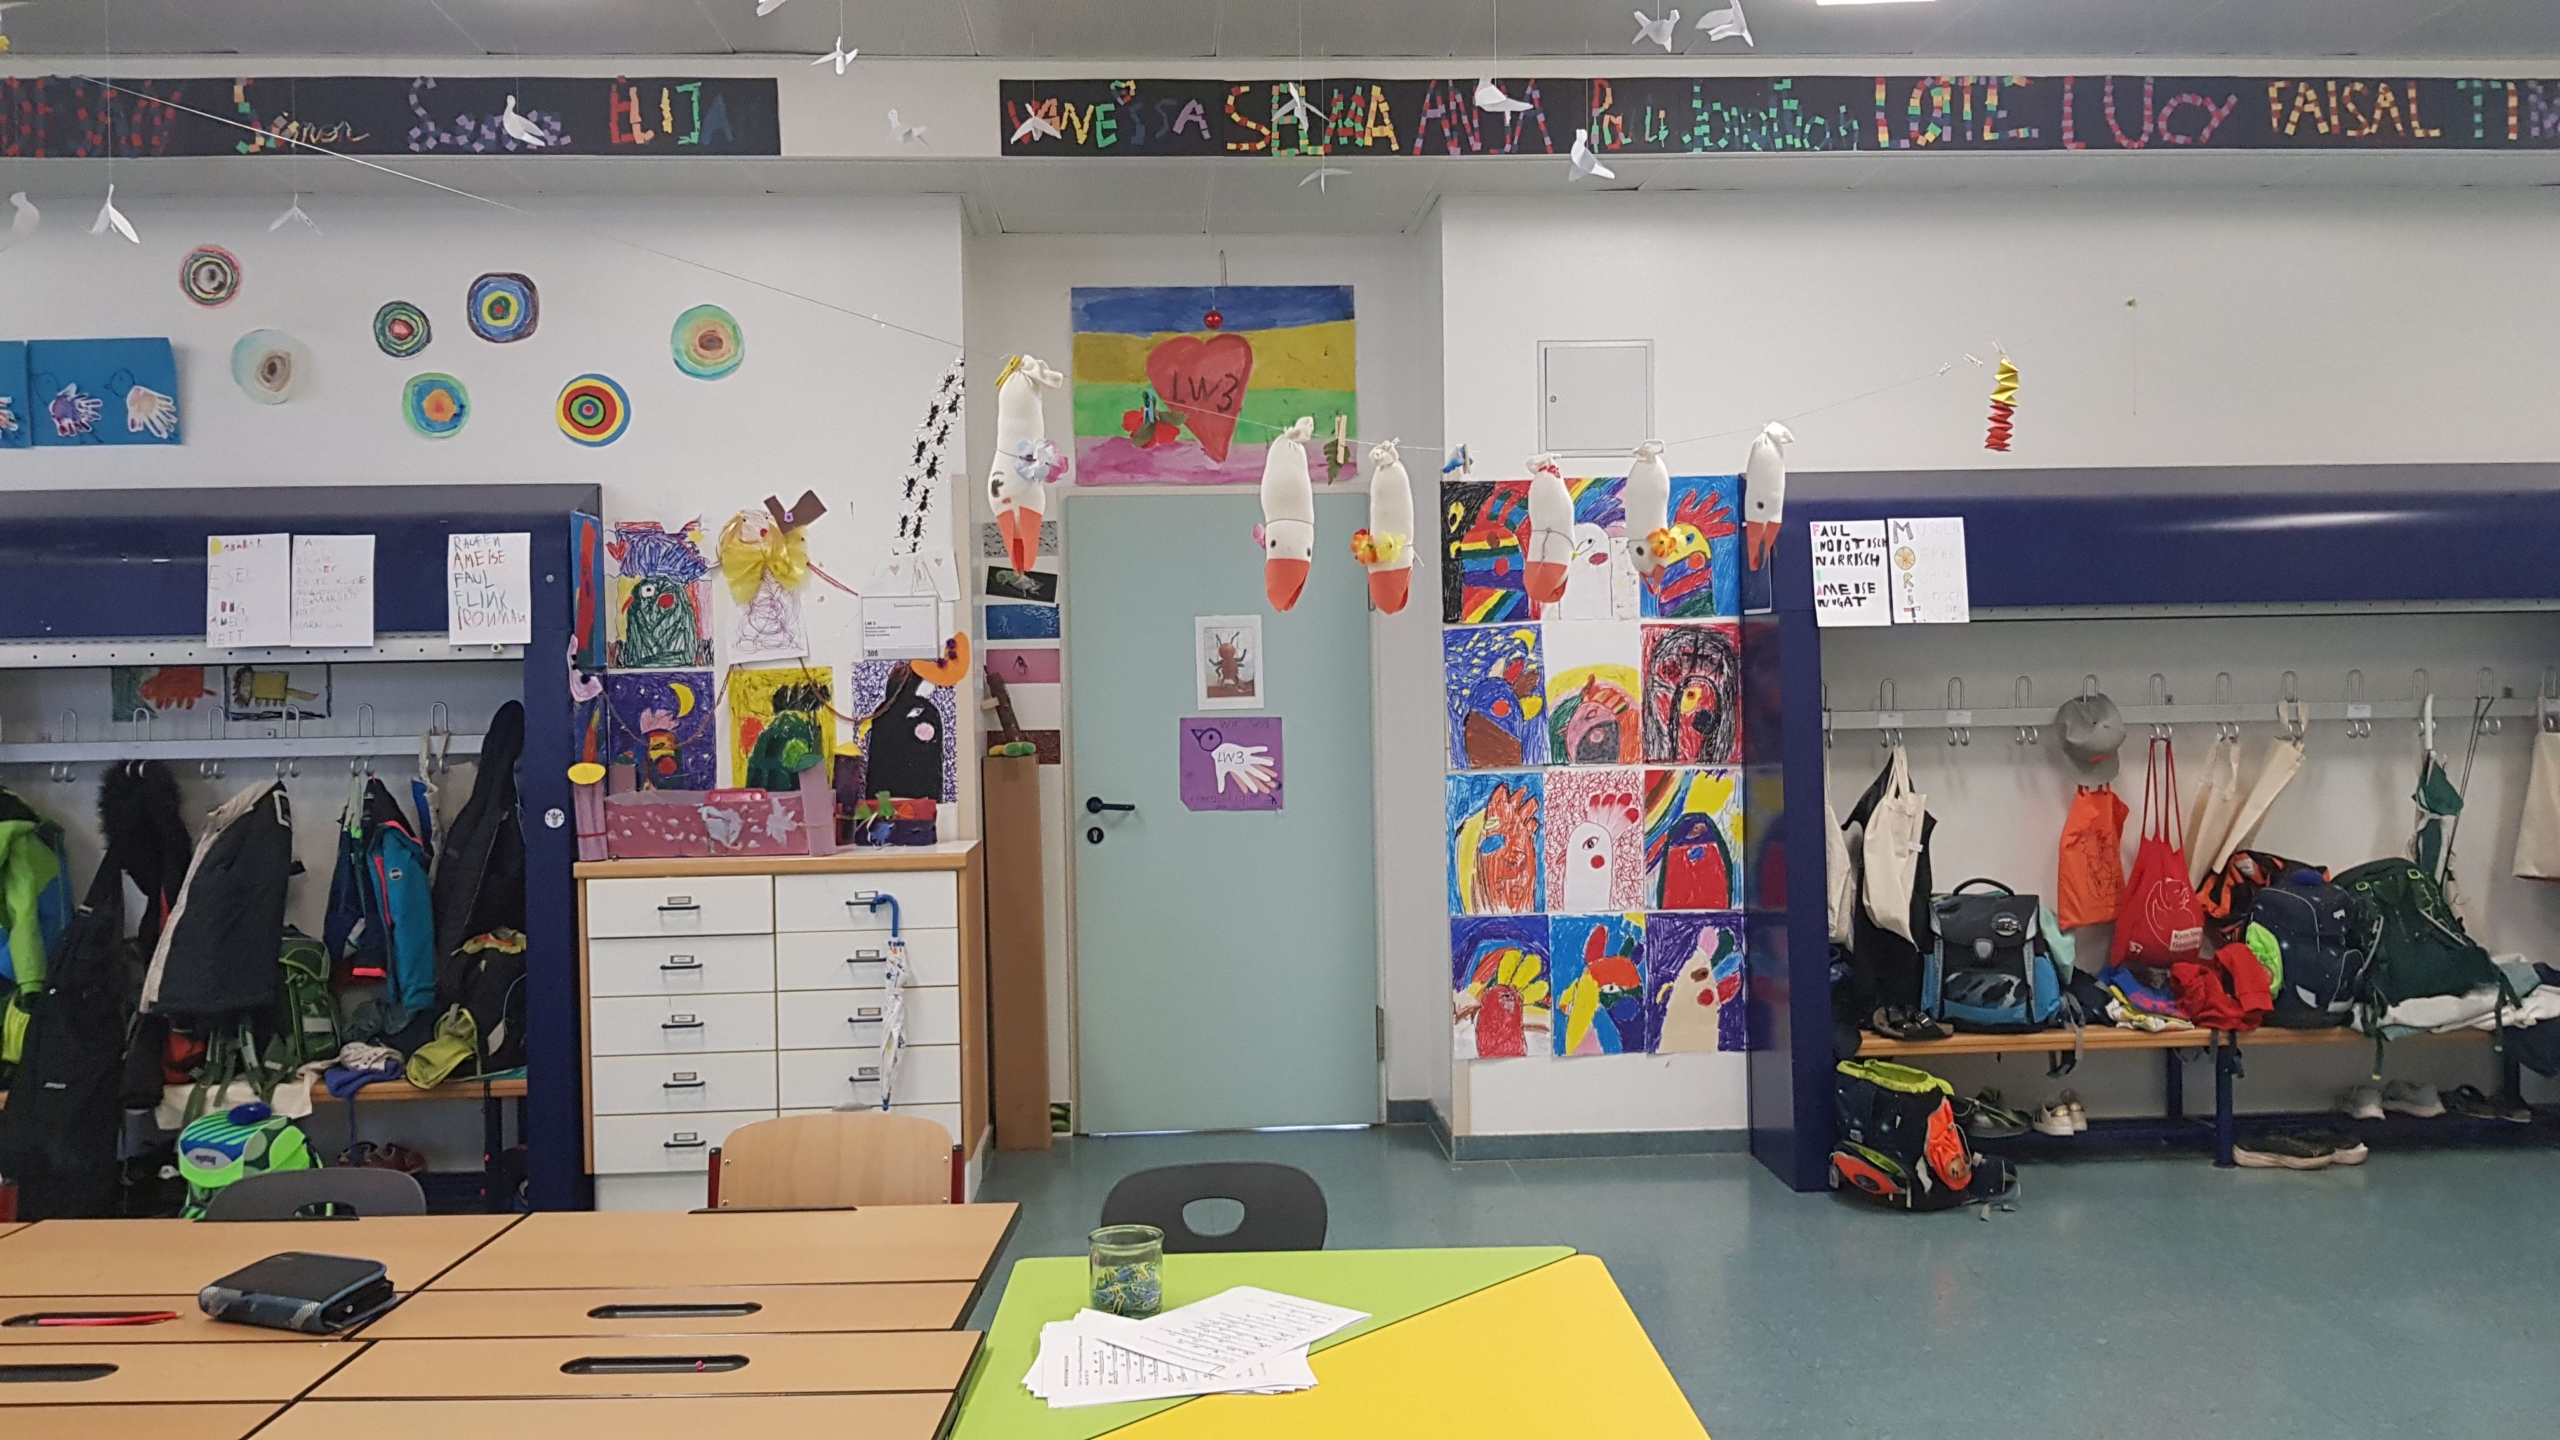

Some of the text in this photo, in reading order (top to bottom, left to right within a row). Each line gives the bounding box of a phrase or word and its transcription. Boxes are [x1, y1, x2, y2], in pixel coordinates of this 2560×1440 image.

[2268, 80, 2441, 136] FAISAL
[1812, 523, 1850, 537] FAUL
[453, 549, 505, 571] AMEISE
[453, 569, 495, 589] FAUL
[1816, 582, 1876, 596] AMEISE
[1817, 596, 1867, 609] NUGAT
[1217, 751, 1245, 765] LW3
